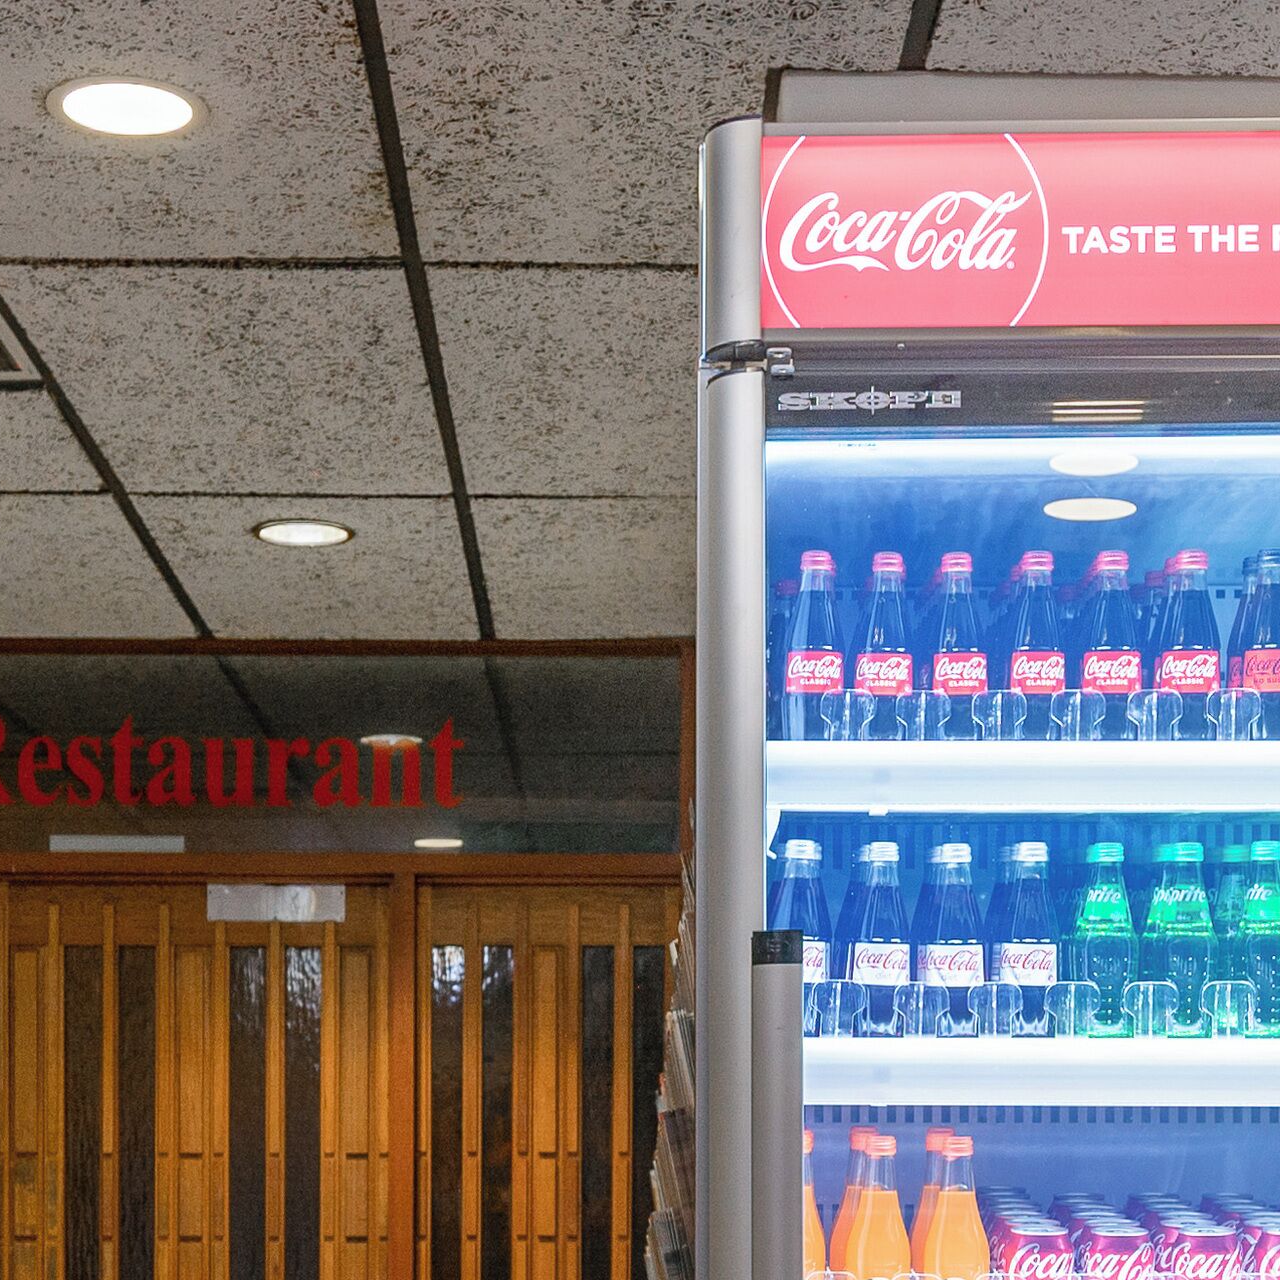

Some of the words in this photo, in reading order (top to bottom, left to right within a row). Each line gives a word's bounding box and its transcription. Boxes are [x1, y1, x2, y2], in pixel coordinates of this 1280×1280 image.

[779, 190, 1032, 272] Coca-Cola
[1062, 226, 1177, 255] TASTE
[1187, 224, 1260, 254] THE
[788, 656, 842, 679] Coca-Cola
[856, 657, 911, 680] Coca-Cola
[1084, 655, 1141, 679] Coca-Cola
[1162, 654, 1219, 678] Coca-Cola
